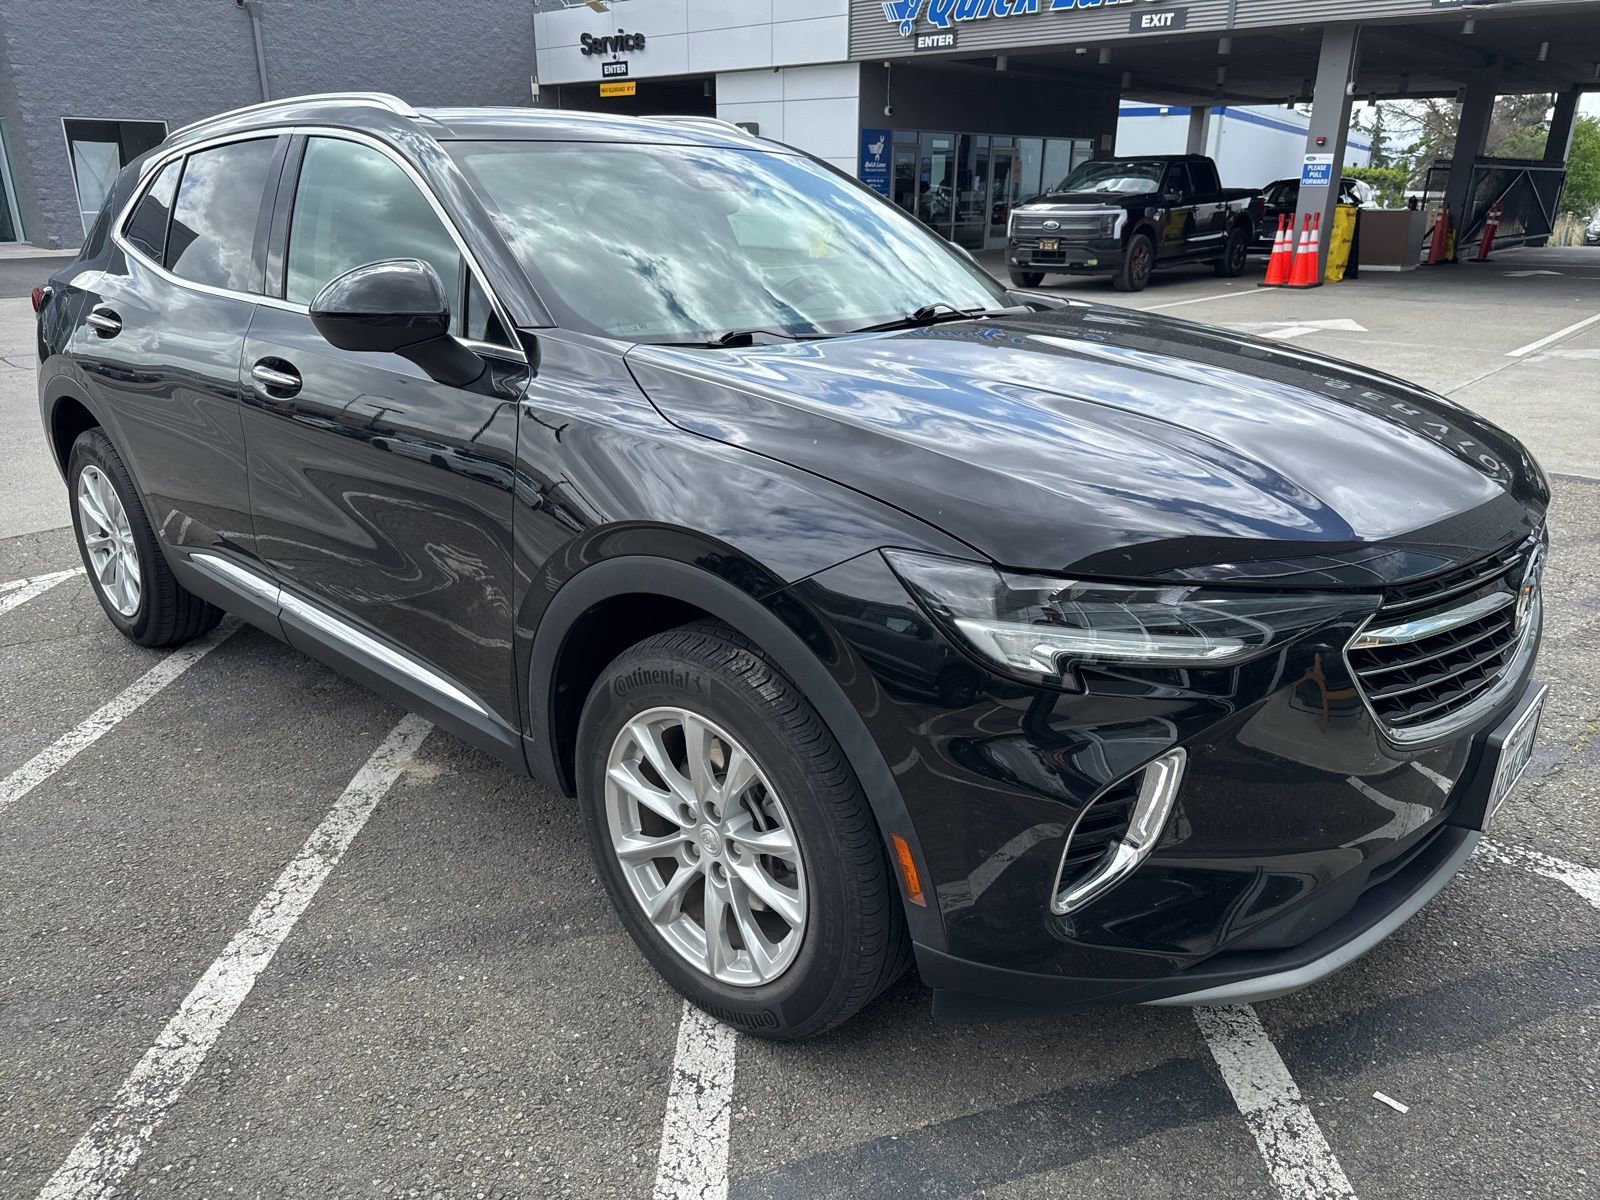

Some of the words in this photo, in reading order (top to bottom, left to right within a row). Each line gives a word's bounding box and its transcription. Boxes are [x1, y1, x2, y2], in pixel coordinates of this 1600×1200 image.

[1141, 13, 1174, 28] EXIT
[580, 29, 646, 56] Service
[918, 34, 954, 48] ENTER
[603, 63, 627, 75] ENTER
[613, 666, 690, 697] Continental
